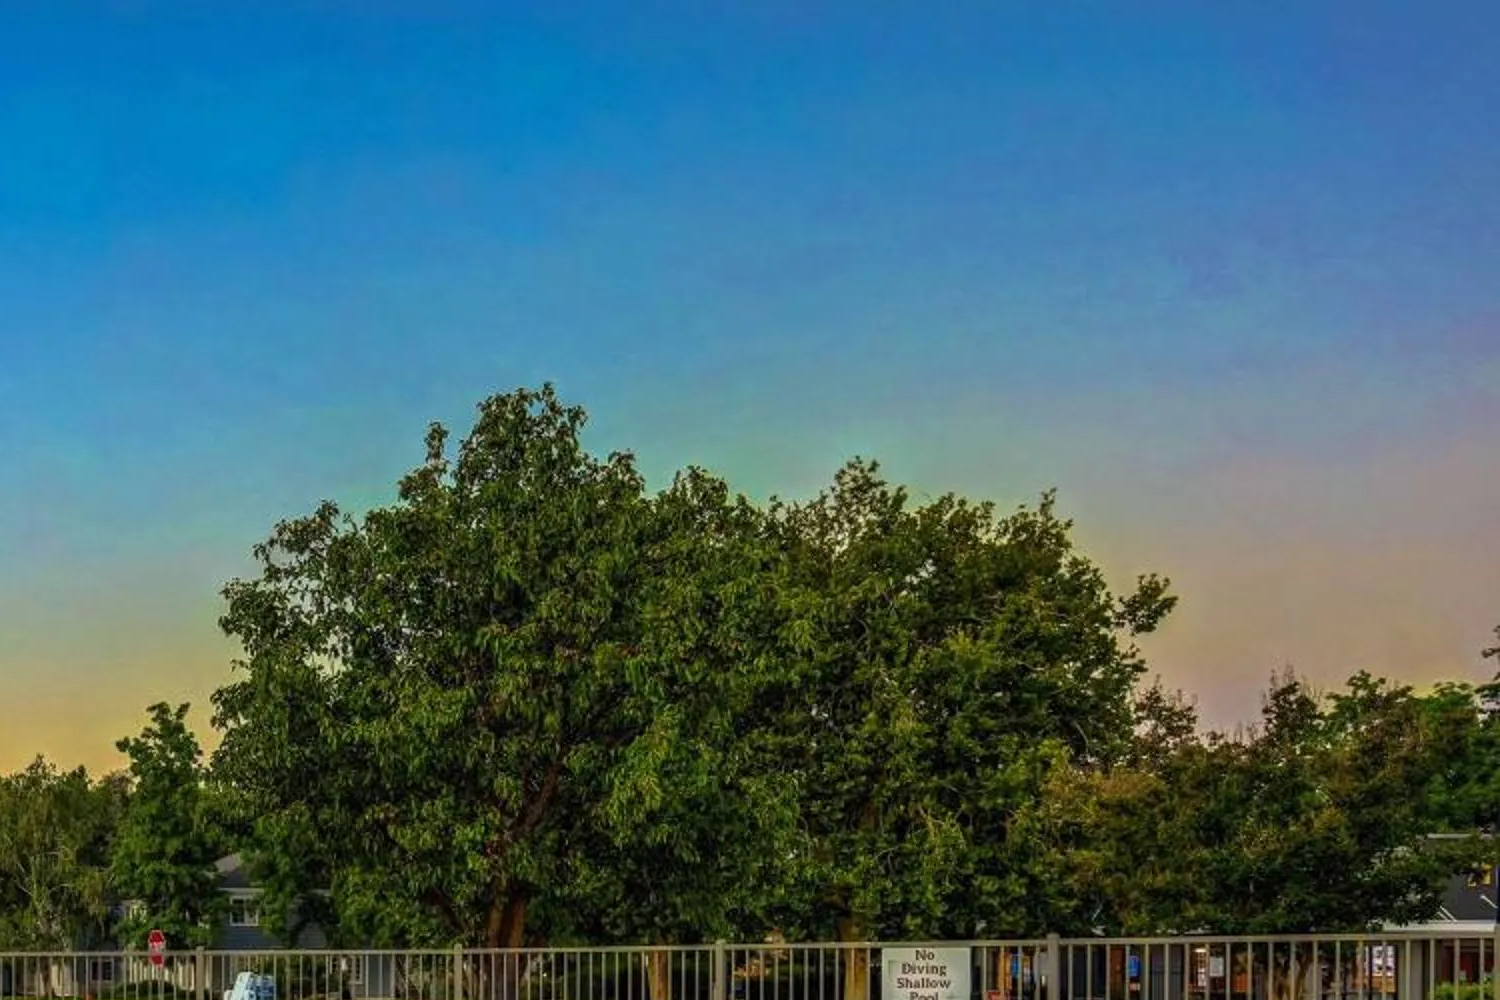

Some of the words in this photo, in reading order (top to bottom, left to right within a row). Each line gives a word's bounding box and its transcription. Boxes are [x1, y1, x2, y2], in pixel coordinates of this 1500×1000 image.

[915, 949, 935, 961] No
[901, 963, 947, 977] Diving
[896, 977, 952, 989] Shallow
